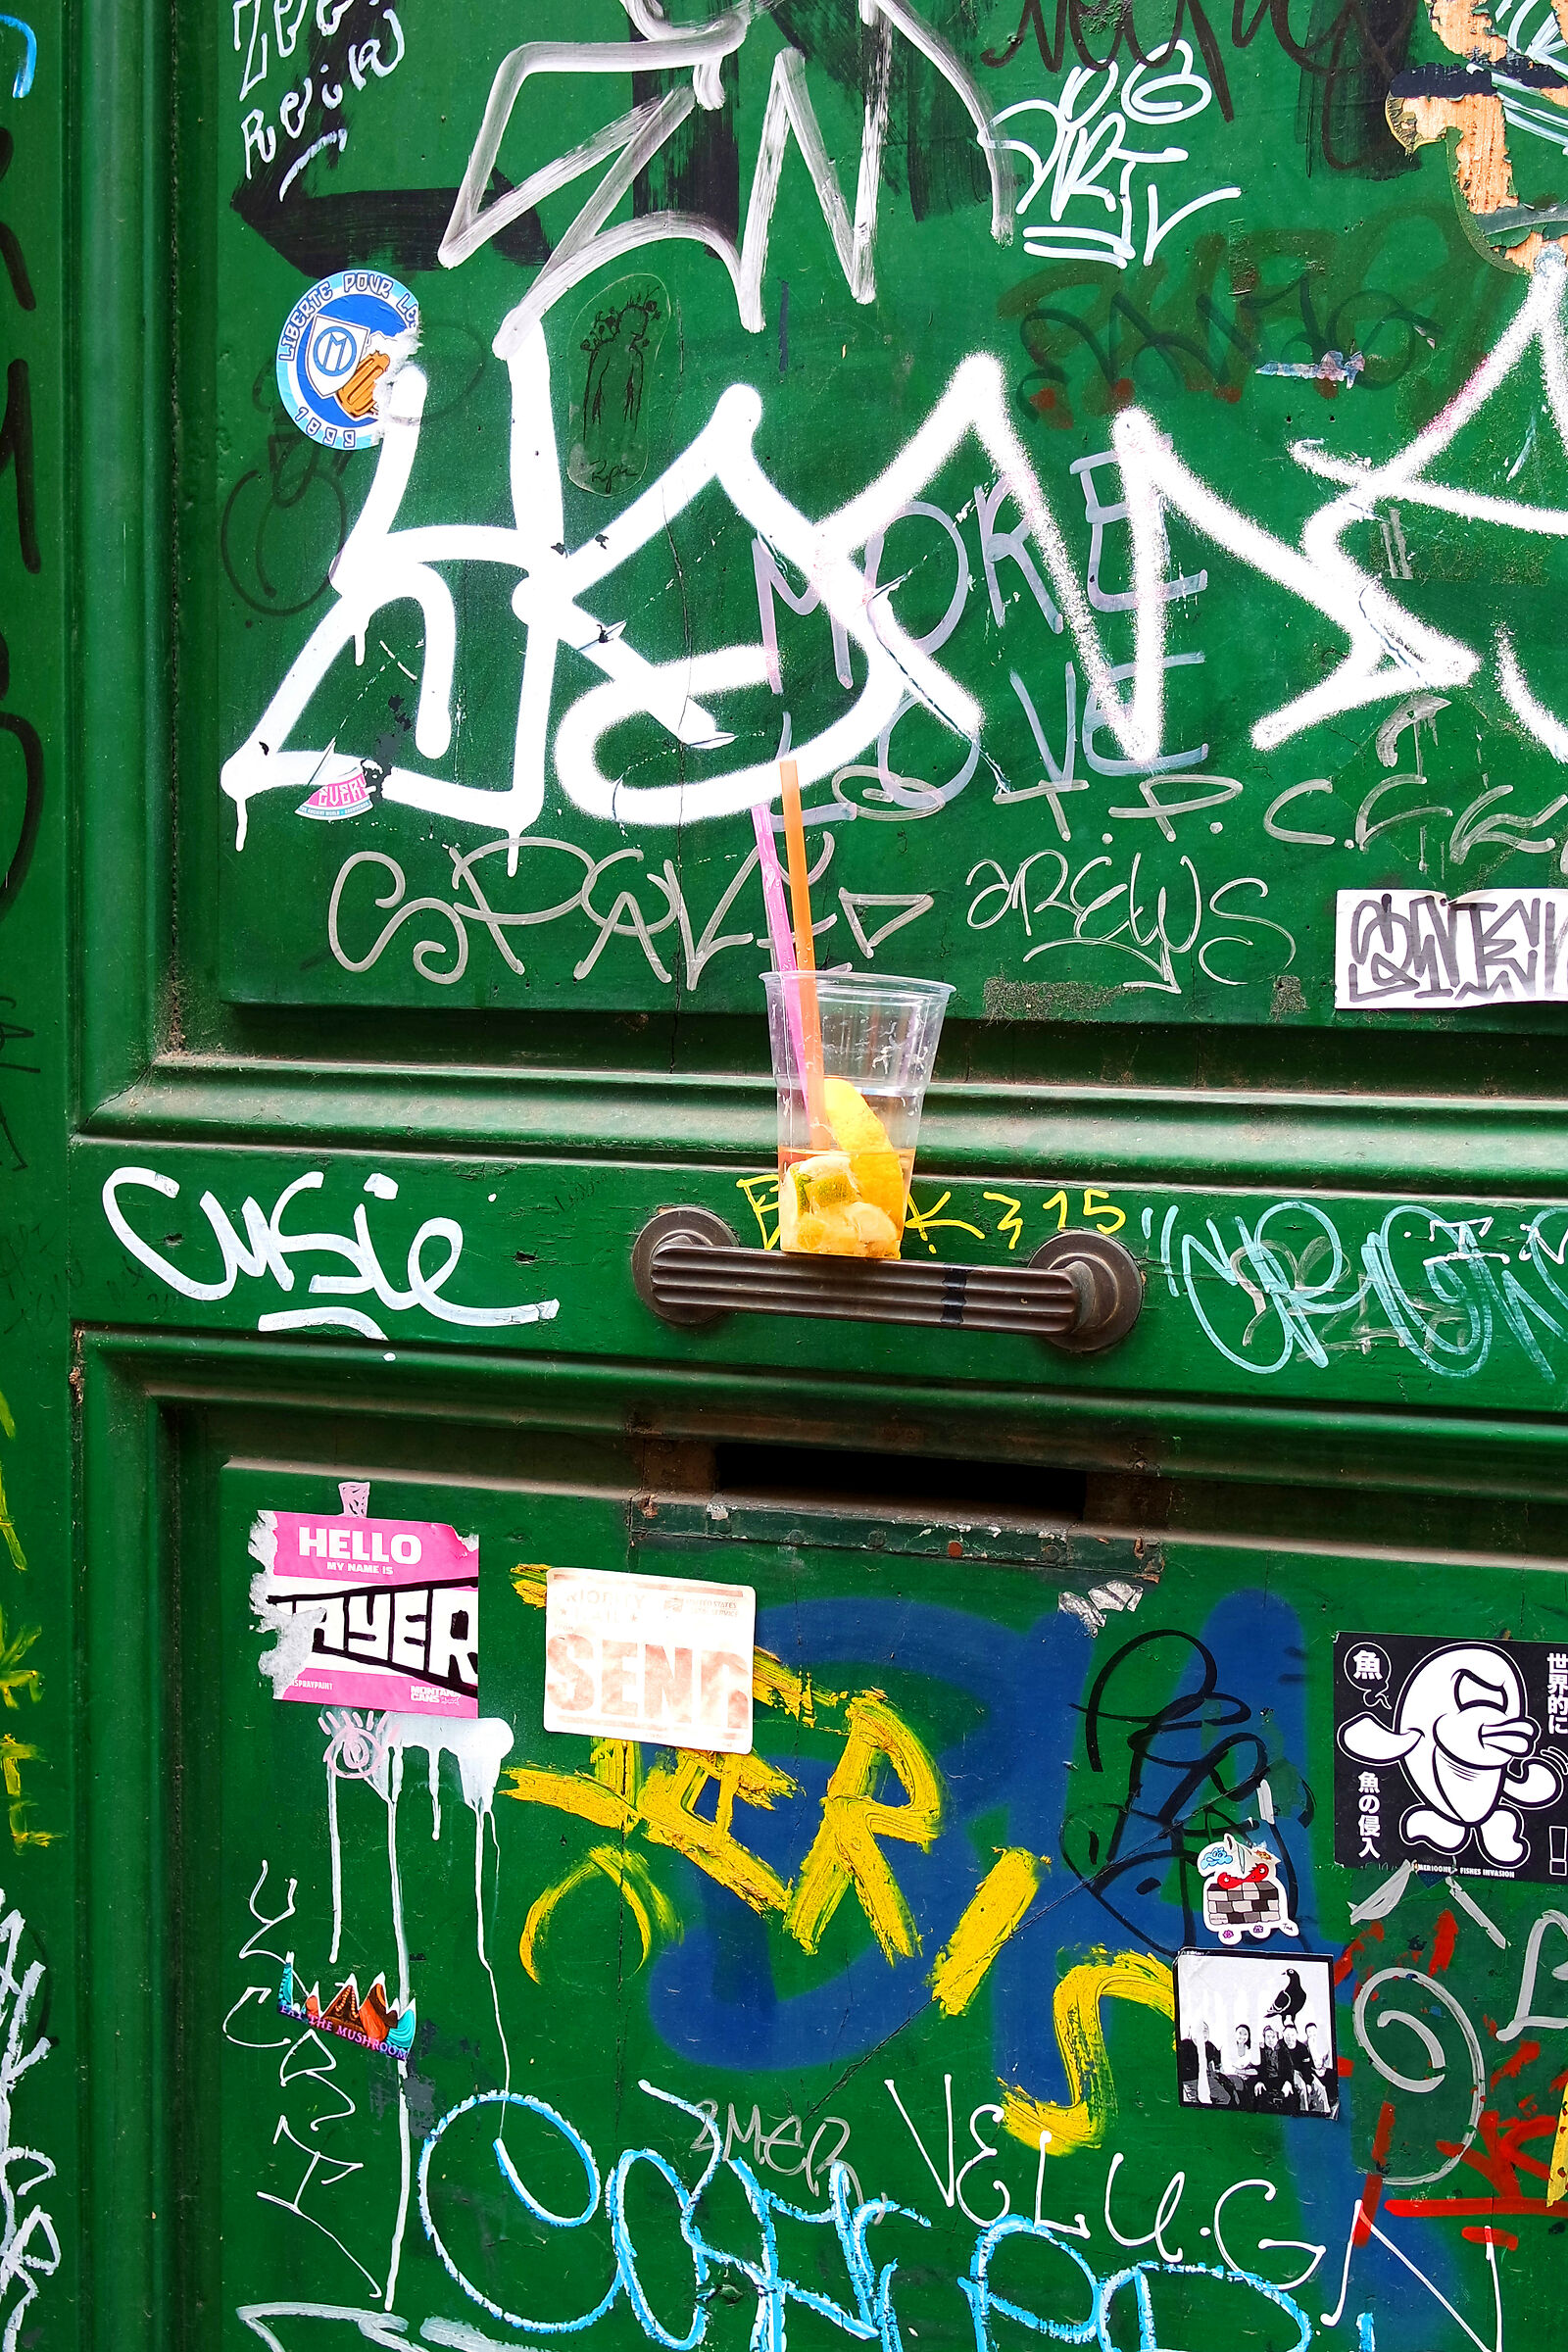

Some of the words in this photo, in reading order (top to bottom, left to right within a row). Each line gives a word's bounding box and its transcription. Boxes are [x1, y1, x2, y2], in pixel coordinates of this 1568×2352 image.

[278, 280, 333, 362] LIBERTE
[343, 272, 394, 300] POUR
[294, 406, 357, 449] 1899
[298, 1526, 422, 1565] HELLO
[326, 1561, 345, 1571] MY
[347, 1562, 380, 1575] NAME
[382, 1566, 394, 1576] IS
[1352, 1649, 1384, 1681] 魚
[1356, 1771, 1381, 1860] 魚の侵入
[1459, 1866, 1482, 1876] FISHES
[1482, 1868, 1515, 1879] INVASION
[307, 2013, 333, 2033] THE
[335, 2025, 408, 2062] MUSHROOM
